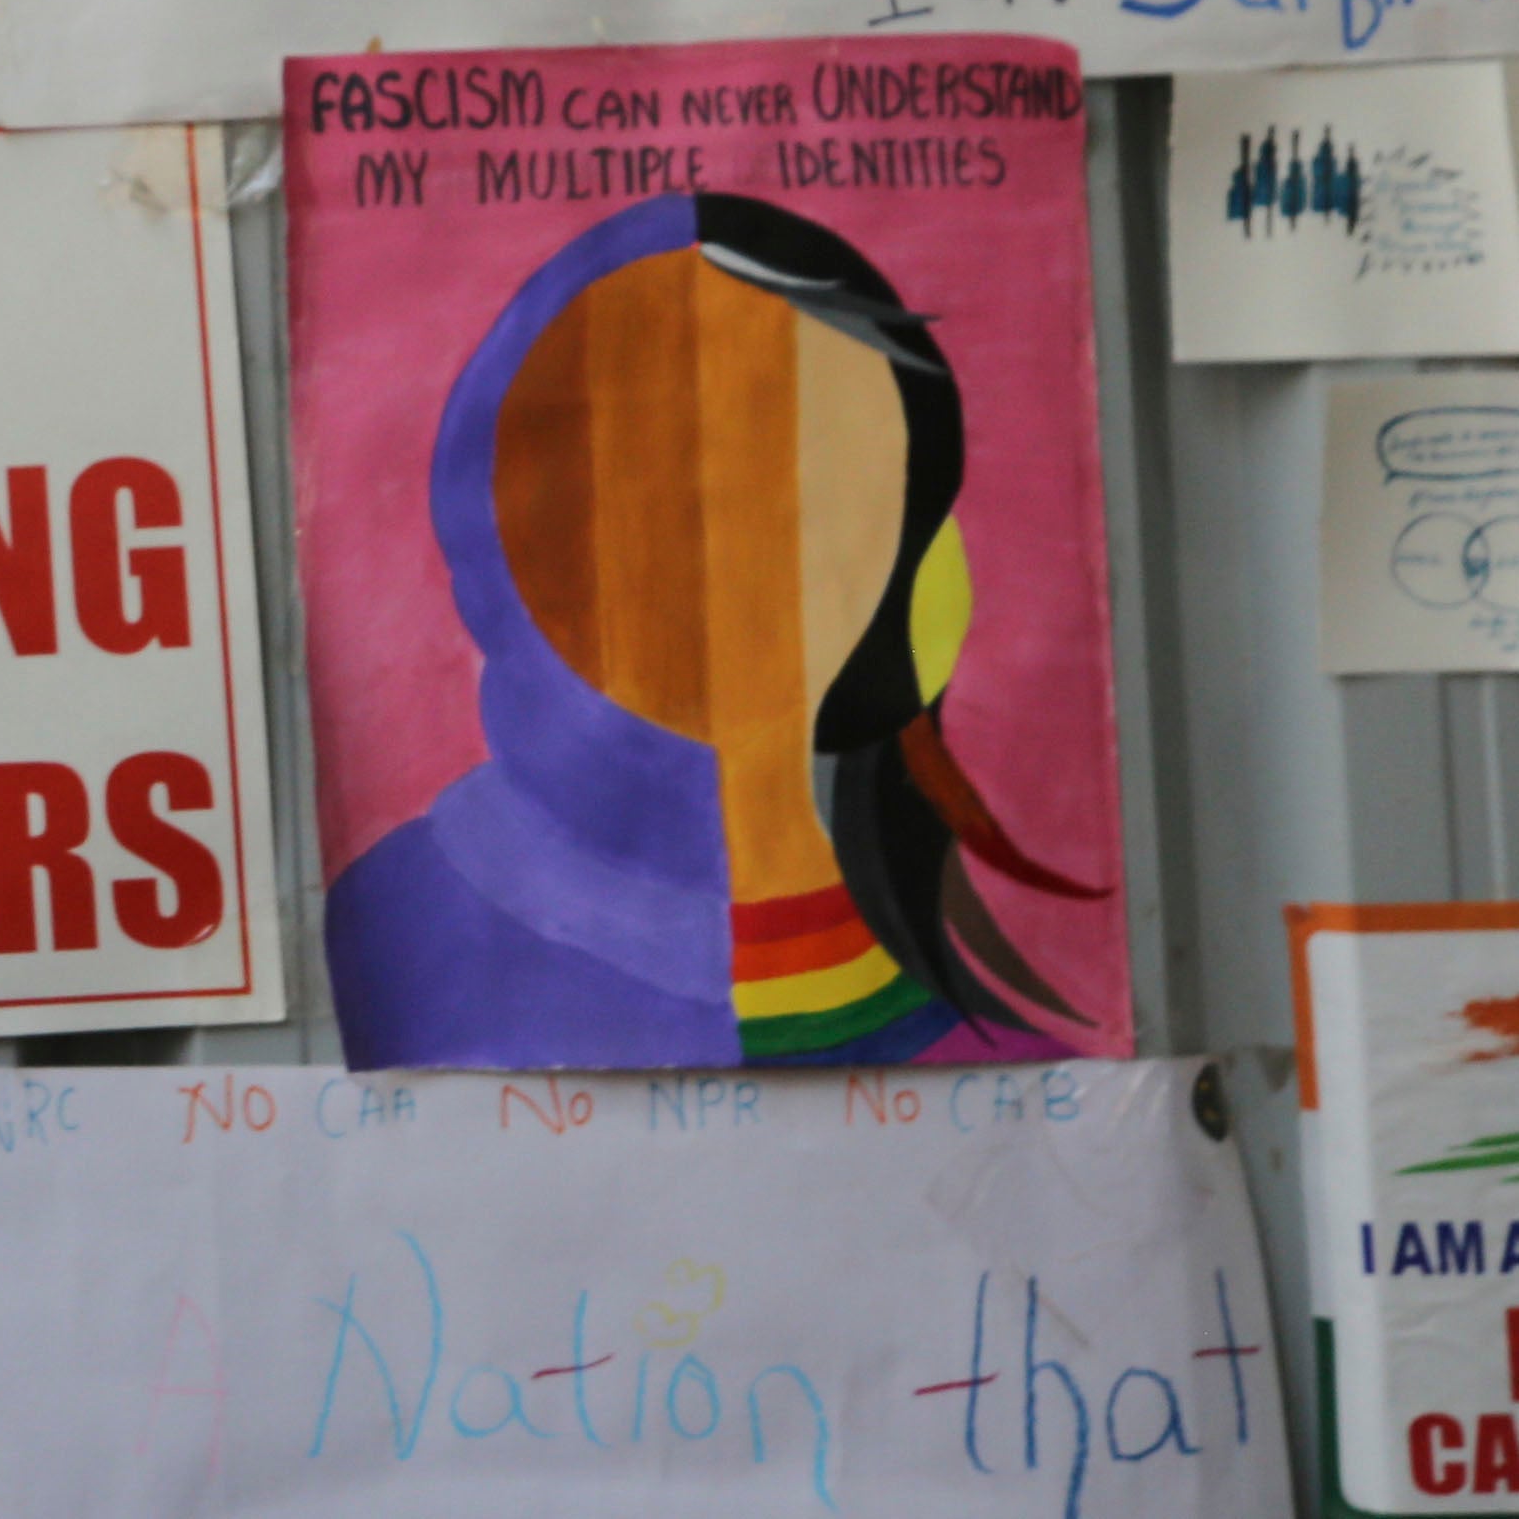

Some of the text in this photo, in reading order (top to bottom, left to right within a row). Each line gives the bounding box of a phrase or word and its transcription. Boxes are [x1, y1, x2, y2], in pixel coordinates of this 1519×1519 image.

[312, 58, 1083, 134] FASCISM CAN NEVER UNDERSTAND
[355, 136, 1008, 209] MY MULTIPLE IDENTITIES
[316, 1080, 418, 1140] CAA
[647, 1078, 764, 1132] NPR
[949, 1072, 1084, 1133] CAB
[1361, 1220, 1375, 1276] I
[1390, 1219, 1485, 1276] AM
[135, 1292, 229, 1482] A
[307, 1226, 839, 1515] Nation
[912, 1266, 1264, 1519] that
